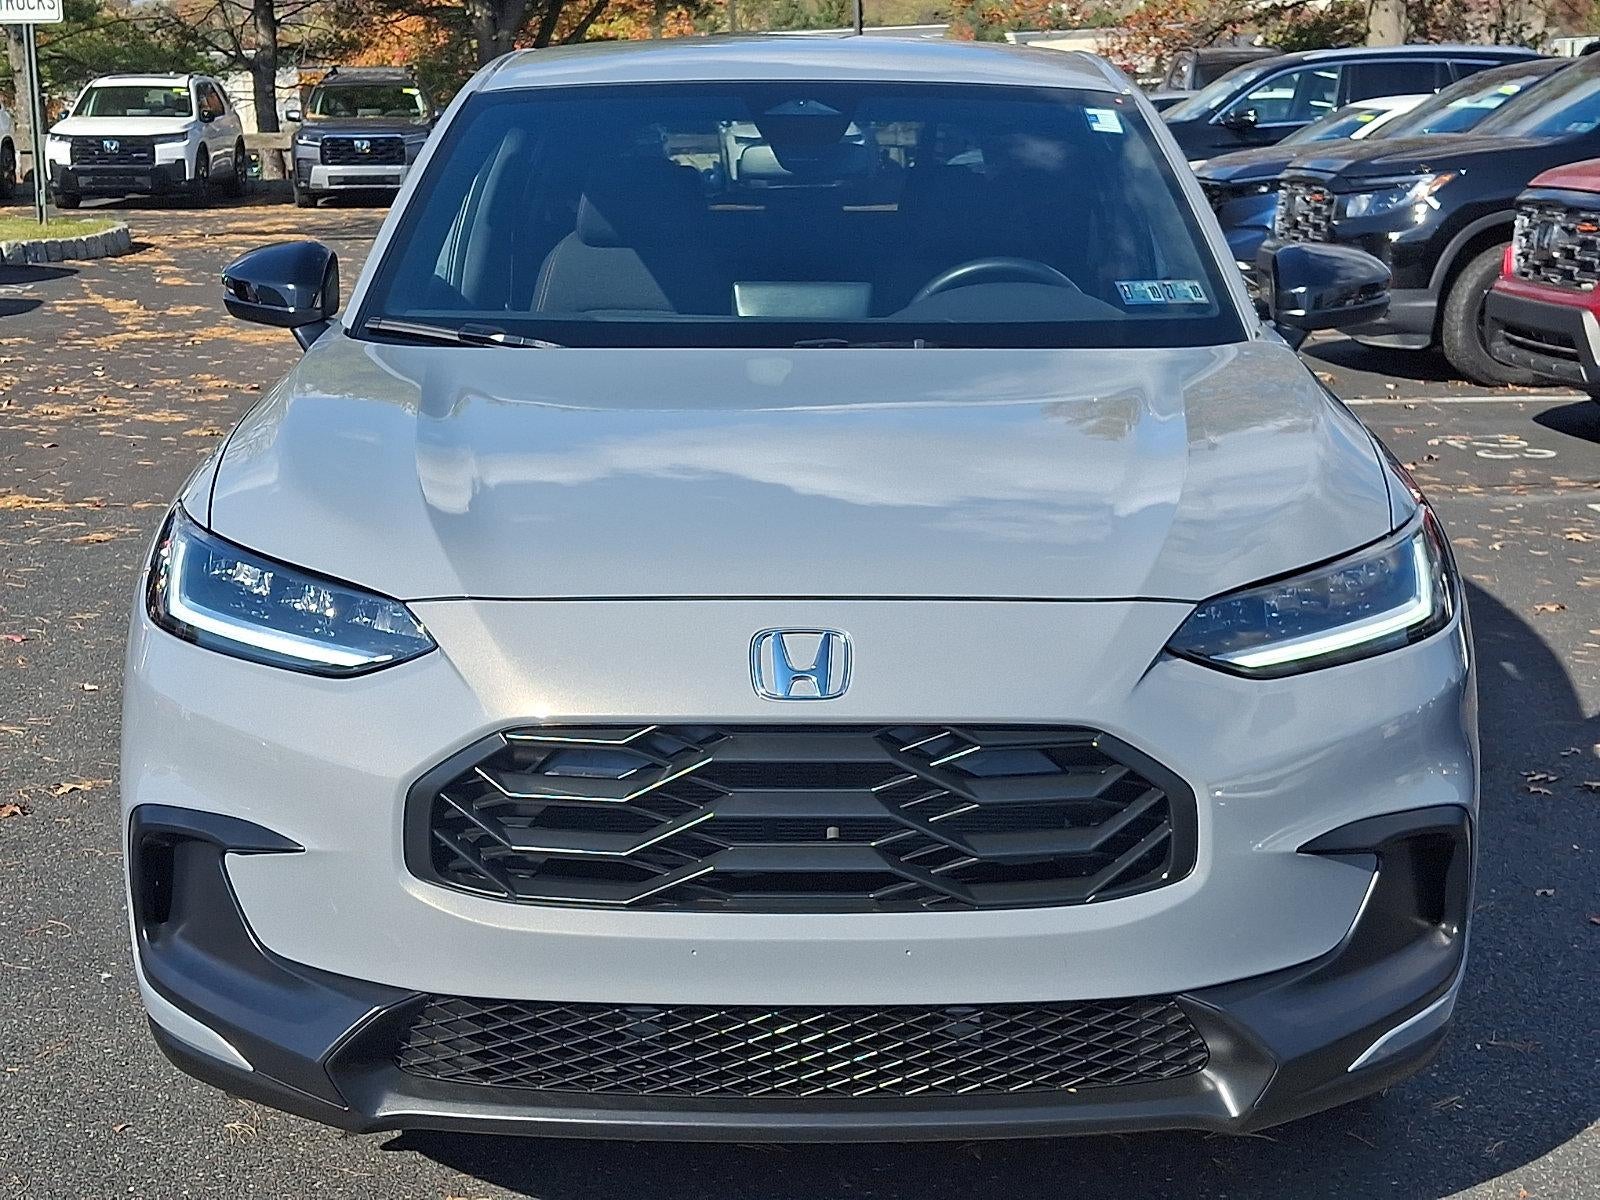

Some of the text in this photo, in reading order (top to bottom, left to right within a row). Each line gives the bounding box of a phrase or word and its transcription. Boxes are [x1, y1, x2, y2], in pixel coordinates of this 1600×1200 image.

[1148, 286, 1162, 299] 10
[1162, 283, 1203, 299] 27 10
